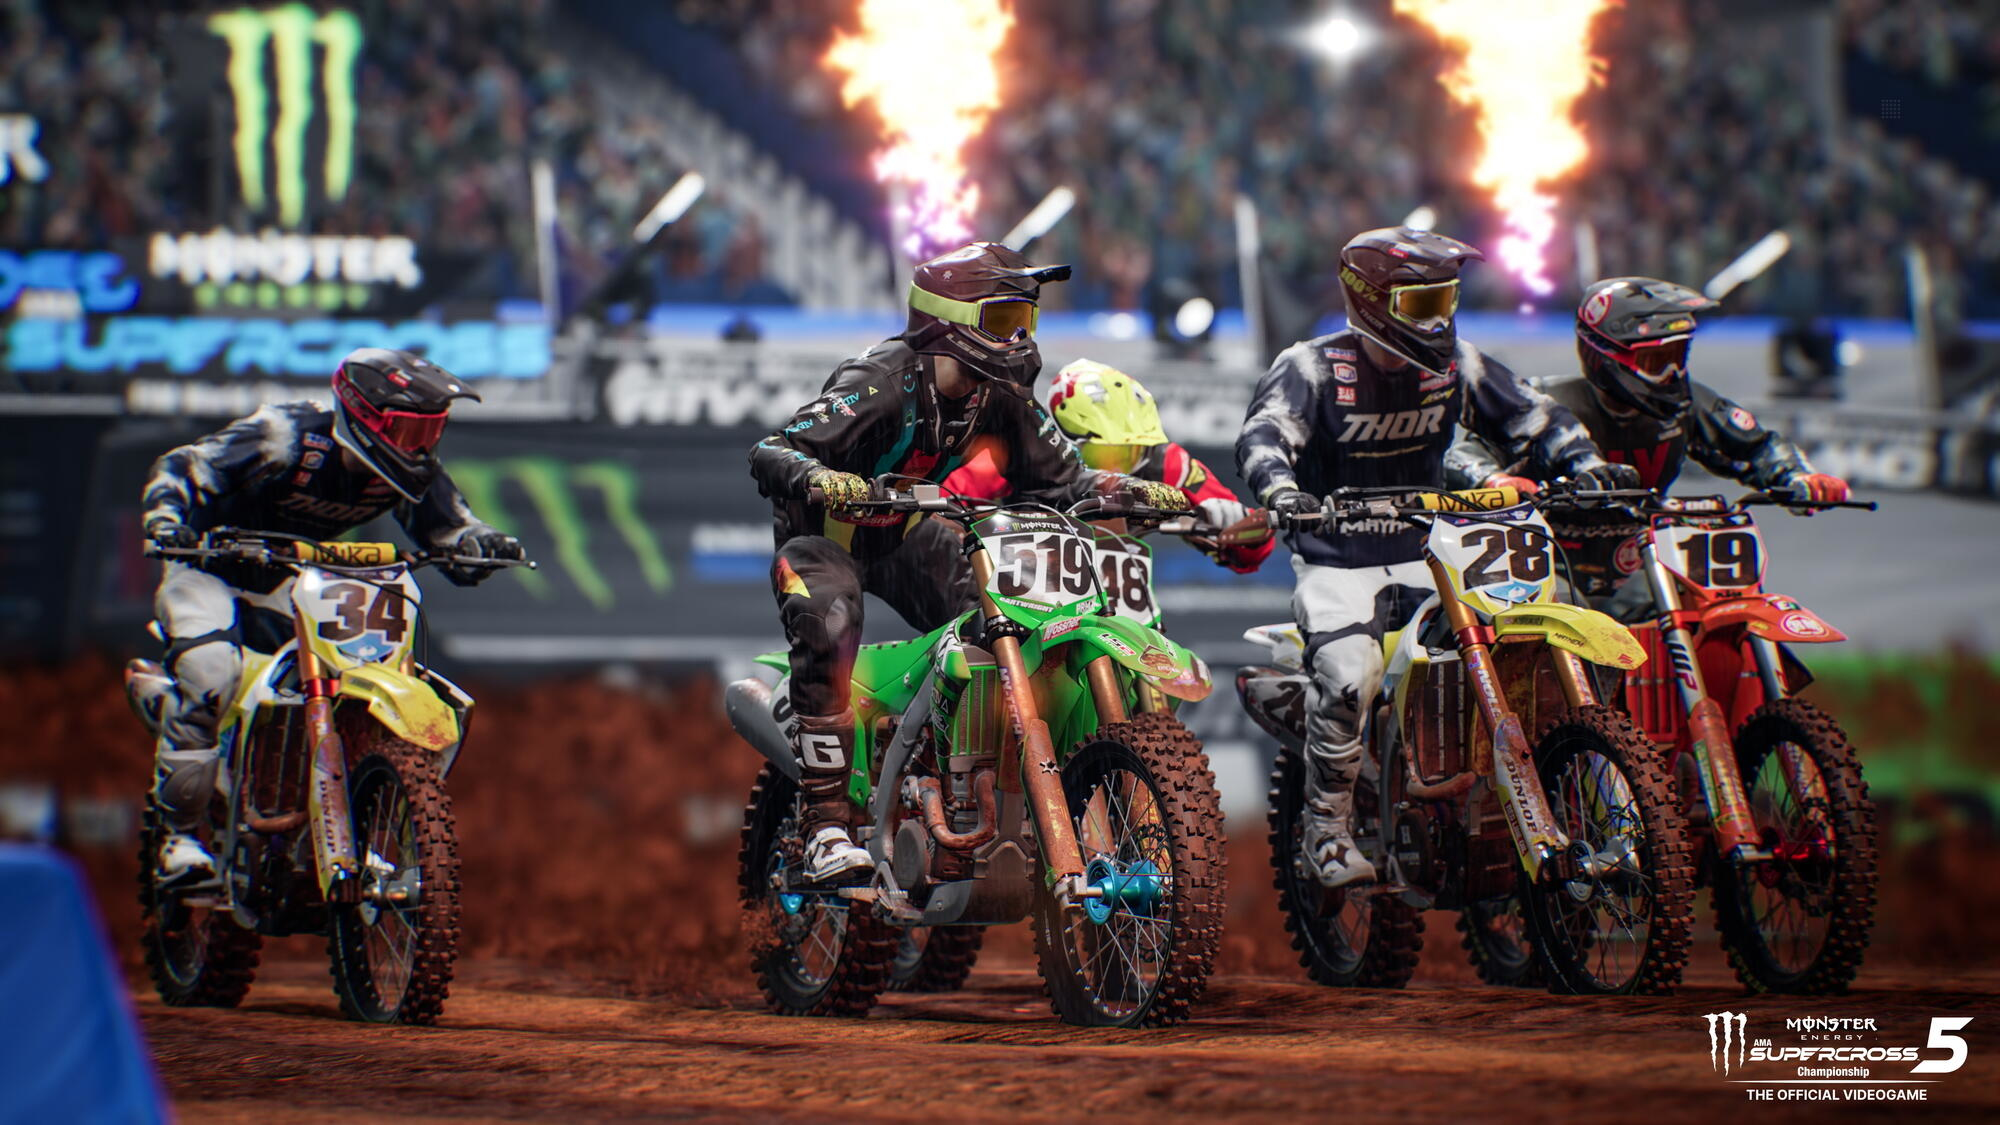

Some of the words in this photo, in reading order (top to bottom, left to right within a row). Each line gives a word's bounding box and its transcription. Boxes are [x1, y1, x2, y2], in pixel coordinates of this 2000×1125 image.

[1340, 266, 1379, 302] 100%
[1337, 405, 1446, 442] THOR
[279, 493, 378, 521] THOR
[998, 535, 1093, 597] 519
[1461, 524, 1549, 590] 28
[1677, 532, 1759, 587] 19
[318, 583, 407, 642] 34
[319, 780, 337, 853] DUNLOP
[1506, 759, 1538, 833] DUNLOP
